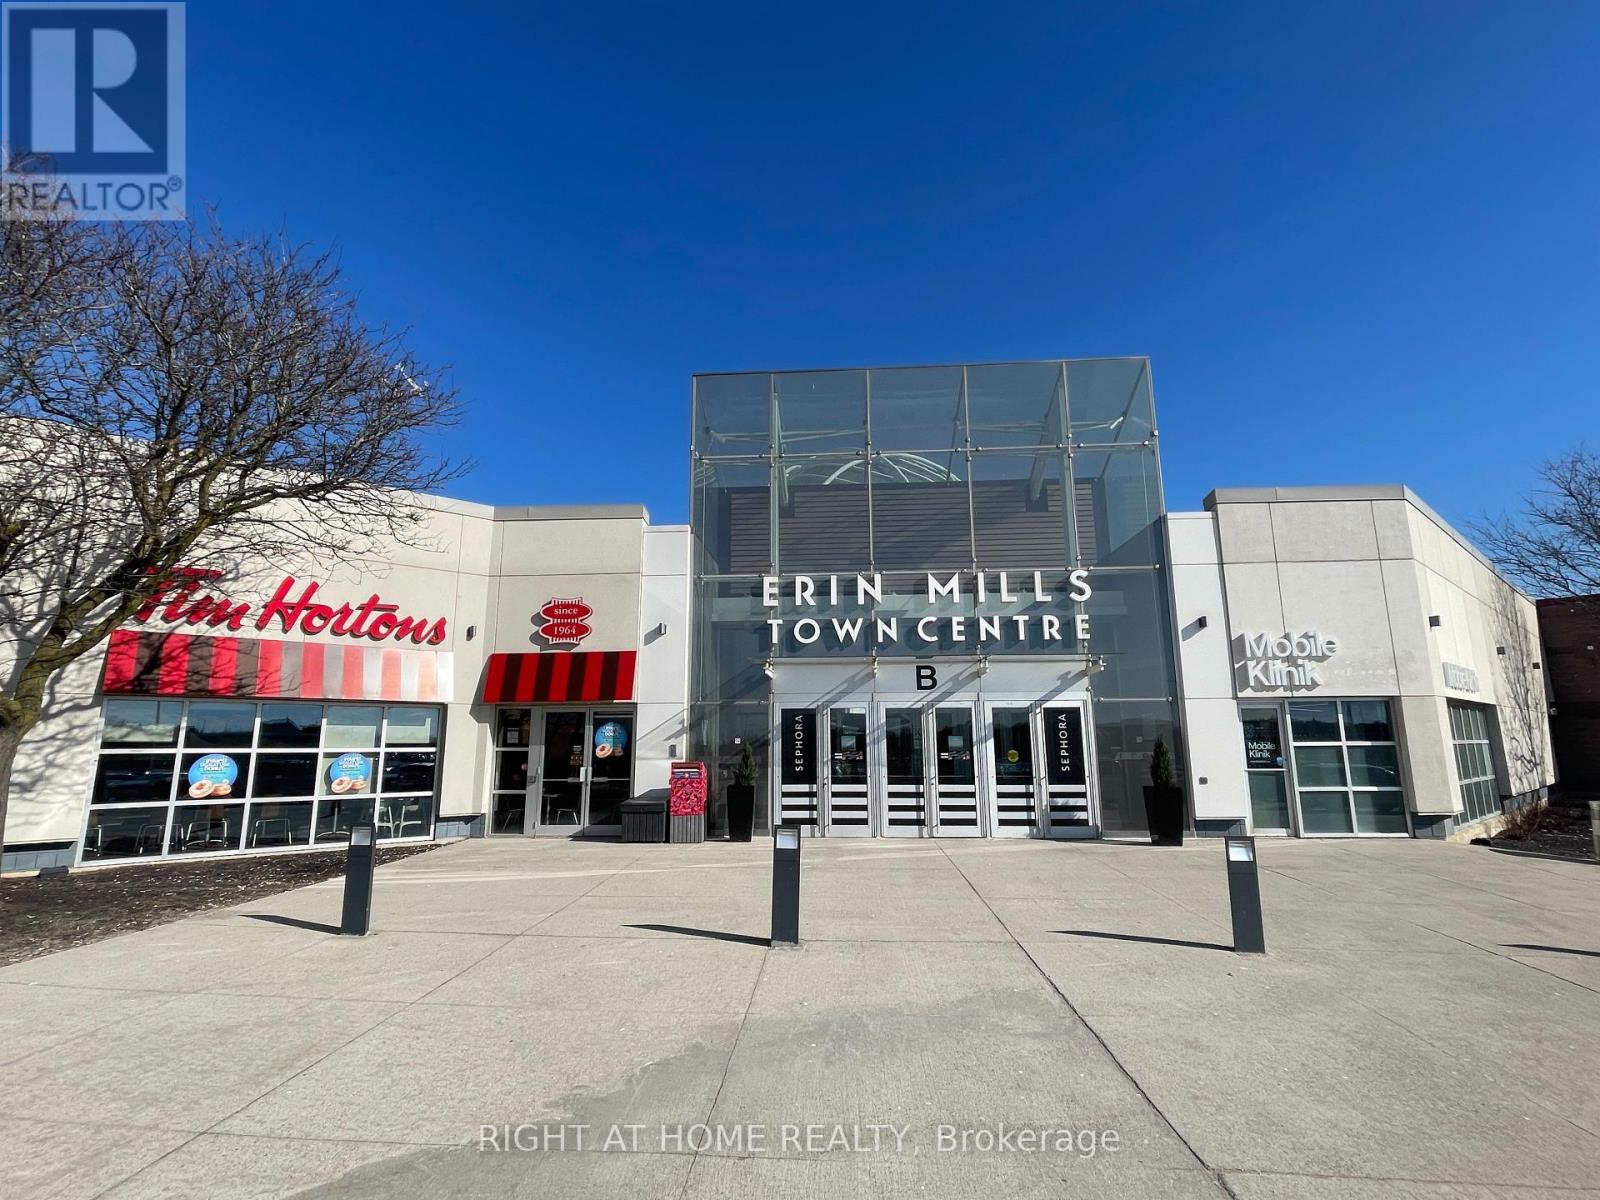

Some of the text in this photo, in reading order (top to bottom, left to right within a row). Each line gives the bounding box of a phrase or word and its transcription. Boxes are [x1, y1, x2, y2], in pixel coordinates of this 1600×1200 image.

[762, 569, 1093, 607] ERIN MILLS
[134, 566, 448, 645] Tim Hortons
[553, 605, 579, 615] since
[554, 625, 577, 635] 1964
[767, 613, 1092, 645] TOWN CENTRE
[1244, 631, 1337, 658] Mobile
[915, 665, 938, 691] B
[1246, 658, 1323, 686] Klinik
[794, 714, 804, 772] SEPHORA
[1057, 713, 1071, 772] SEPHORA
[1248, 741, 1276, 750] Mobile
[1249, 750, 1271, 758] Klinik
